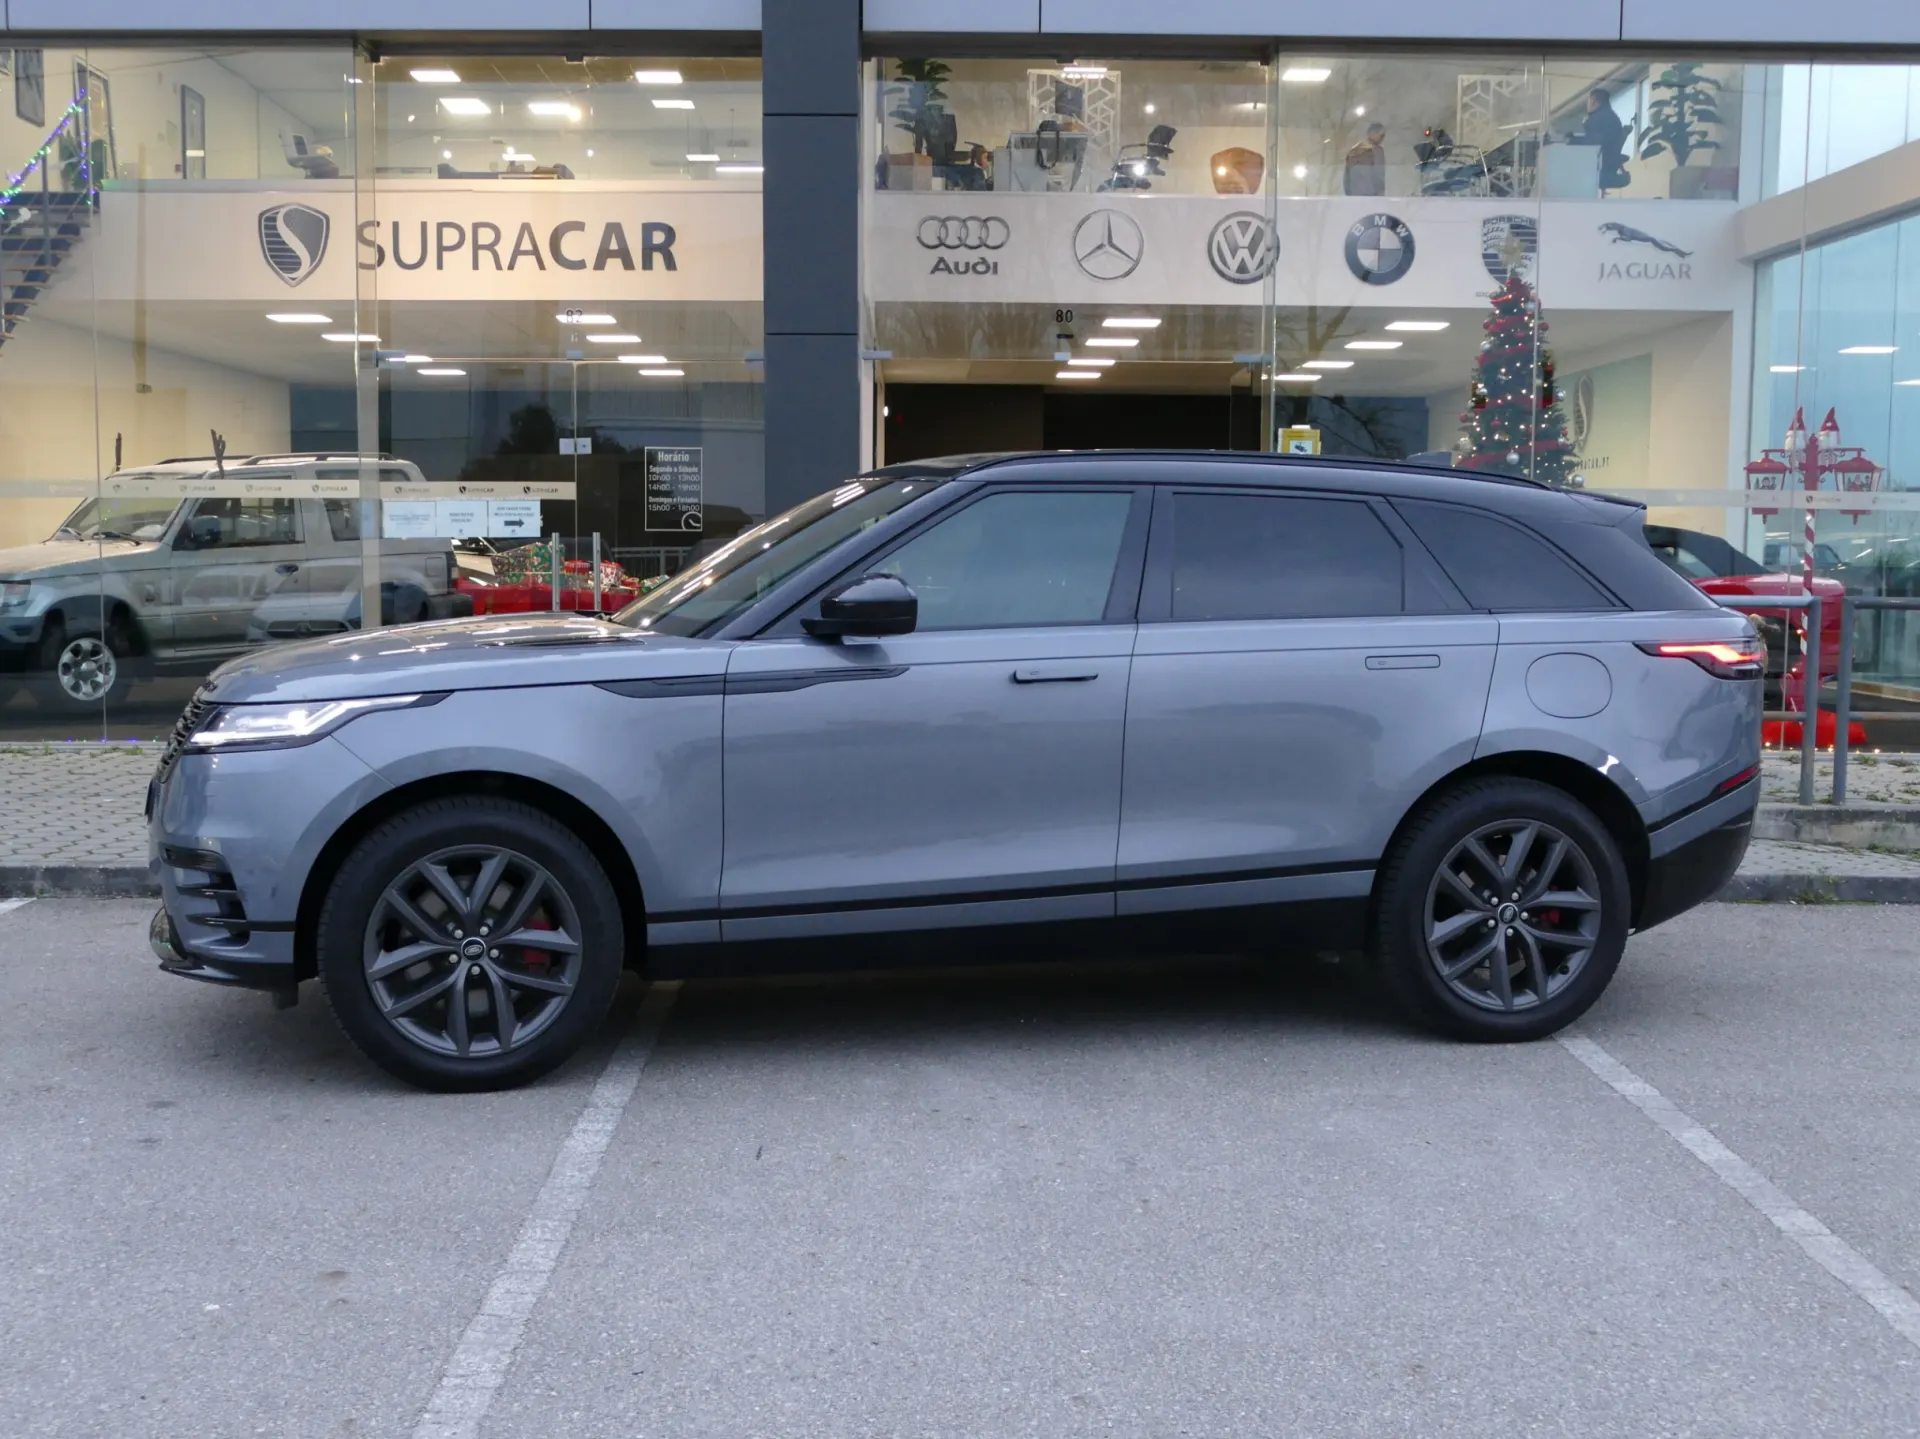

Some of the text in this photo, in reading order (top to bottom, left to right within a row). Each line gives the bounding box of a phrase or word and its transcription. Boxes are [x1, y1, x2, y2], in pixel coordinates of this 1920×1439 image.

[1351, 215, 1409, 237] BMW
[1483, 214, 1537, 228] PORSCHE
[356, 219, 678, 271] SUPRACAR
[930, 256, 999, 275] Audi
[1597, 262, 1693, 282] JAGUAR
[565, 308, 583, 325] 82
[1055, 309, 1074, 323] 80
[658, 451, 690, 462] Horário
[648, 504, 671, 512] 15h00
